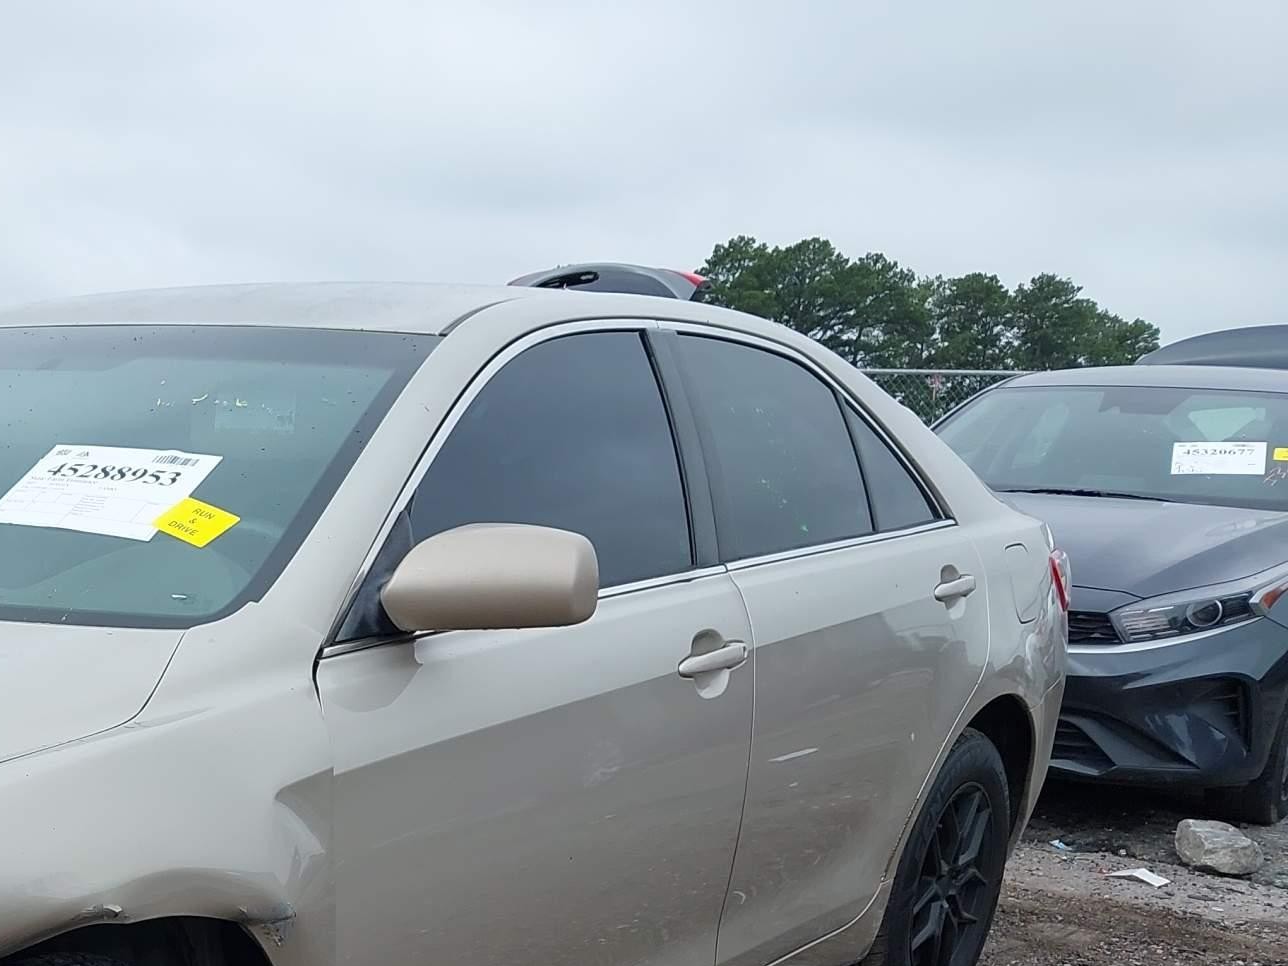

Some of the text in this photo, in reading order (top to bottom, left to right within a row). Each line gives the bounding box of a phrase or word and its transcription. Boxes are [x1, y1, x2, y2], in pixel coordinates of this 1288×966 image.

[1182, 448, 1256, 456] 45320677
[47, 462, 183, 487] 45288953
[191, 508, 216, 520] RUN
[167, 520, 200, 537] DRIVE
